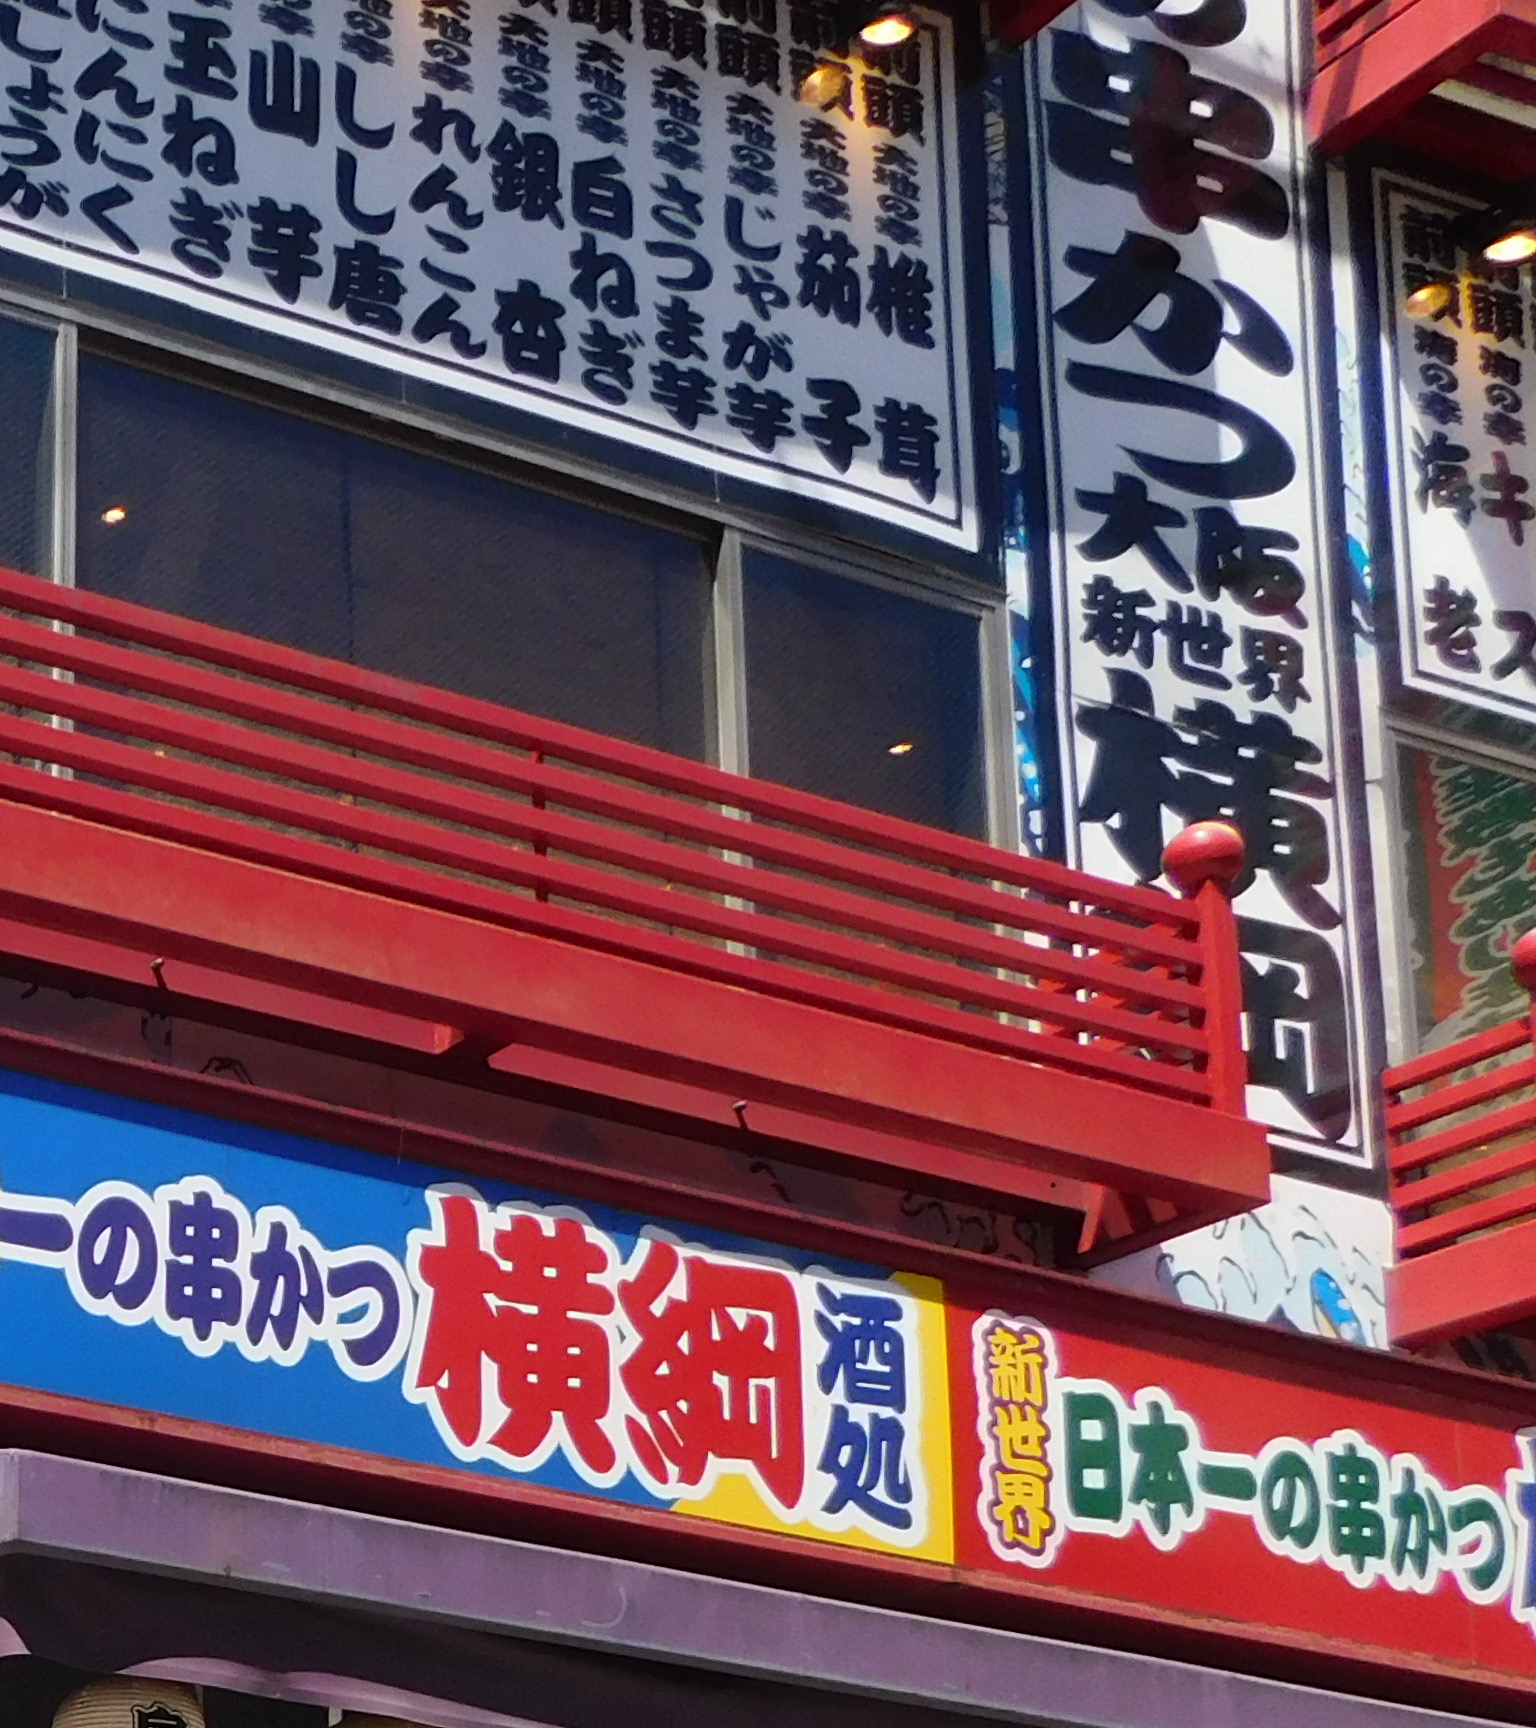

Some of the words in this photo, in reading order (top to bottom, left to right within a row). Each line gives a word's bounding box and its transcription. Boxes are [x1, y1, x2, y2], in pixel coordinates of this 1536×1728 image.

[161, 10, 242, 279] 玉ねぎ
[247, 39, 324, 304] 山芋
[330, 62, 408, 336] しし唐
[408, 92, 488, 360] れんこん
[485, 118, 566, 384] 銀杏
[569, 155, 644, 405] 白ねぎ
[644, 173, 718, 430] さつま芋
[722, 195, 795, 453] じゃが芋
[868, 245, 941, 503] 椎茸
[1076, 472, 1308, 628] 大阪
[1078, 574, 1309, 714] 新世界
[417, 1194, 804, 1510] 横綱
[816, 1280, 914, 1532] 酒処
[984, 1325, 1052, 1553] 新世界
[1063, 1391, 1504, 1597] 日本一の串かつ
